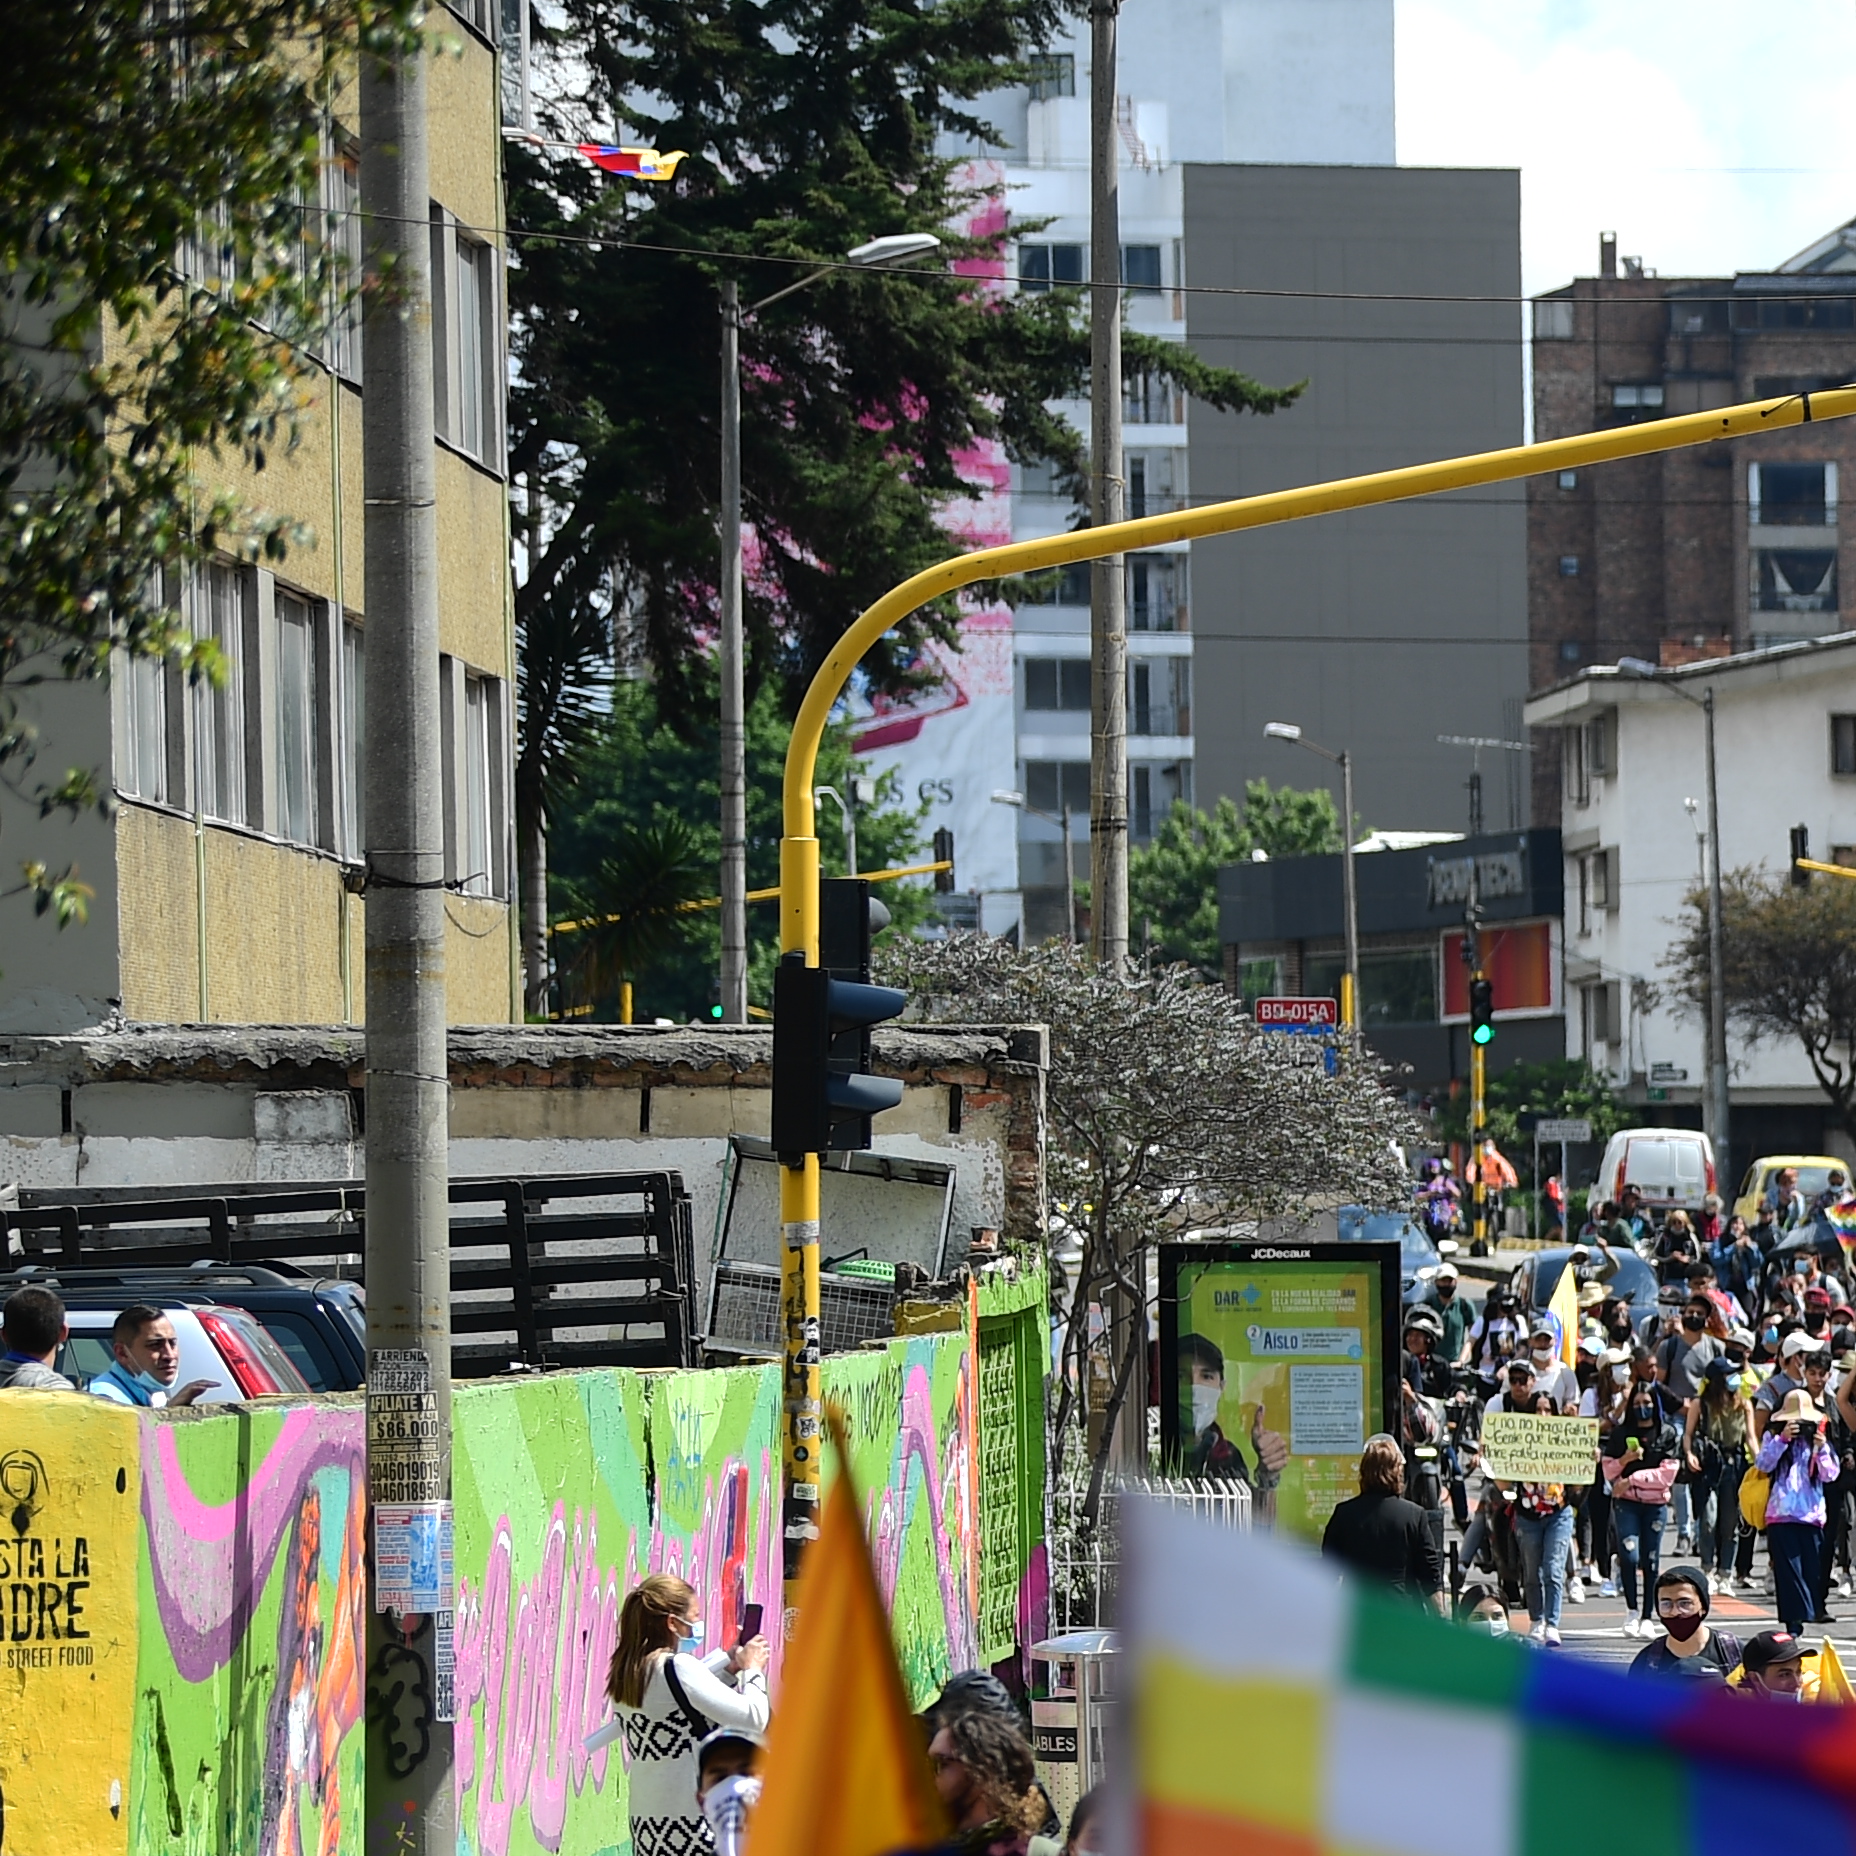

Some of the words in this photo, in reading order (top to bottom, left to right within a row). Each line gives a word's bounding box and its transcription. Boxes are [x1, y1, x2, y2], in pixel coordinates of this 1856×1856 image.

[1250, 1248, 1311, 1260] JCDecaux
[1214, 1290, 1240, 1306] DAR
[1250, 1327, 1257, 1337] 2
[371, 1395, 418, 1411] AFILIATE
[421, 1394, 436, 1410] YA
[377, 1420, 438, 1438] $86.000
[55, 1536, 91, 1578] LA
[7, 1647, 53, 1669] STREET
[59, 1646, 94, 1667] FOOD
